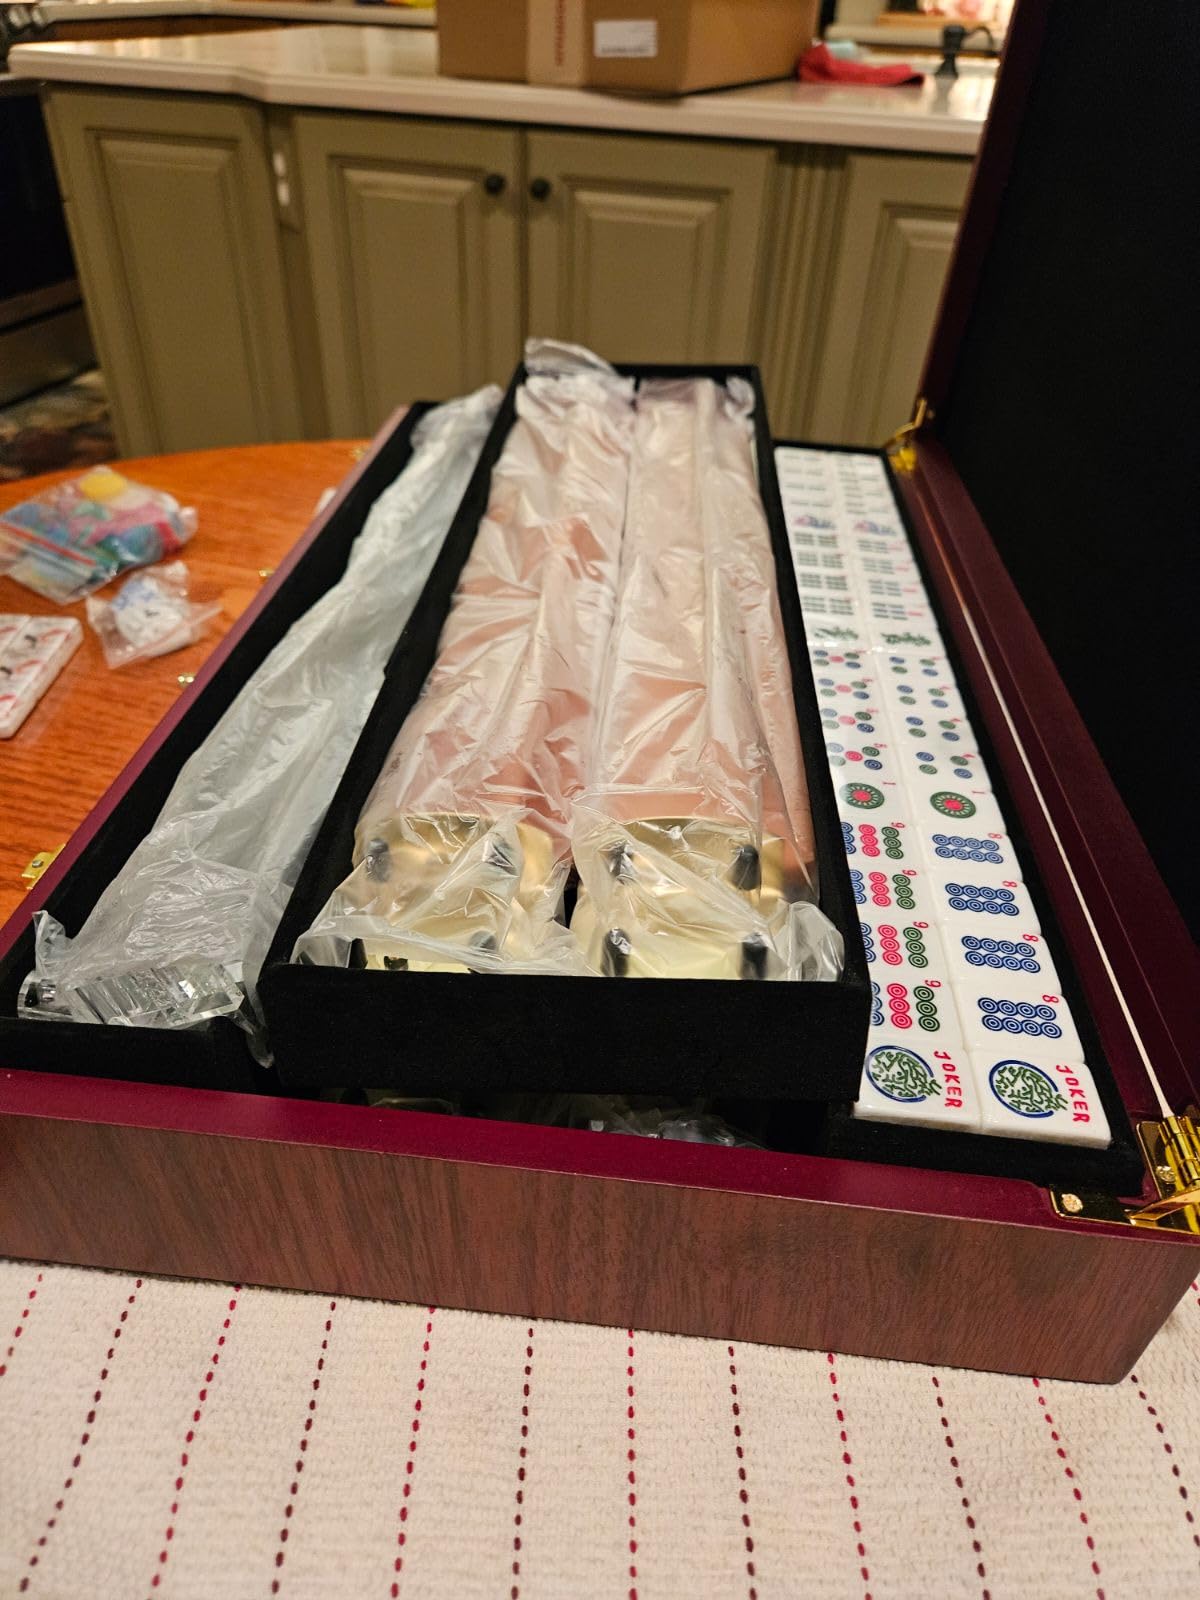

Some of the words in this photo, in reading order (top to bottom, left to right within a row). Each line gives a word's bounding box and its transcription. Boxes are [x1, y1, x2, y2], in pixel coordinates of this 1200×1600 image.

[891, 821, 906, 829] 9
[987, 832, 1002, 840] 8
[902, 869, 917, 877] 9
[1002, 880, 1018, 888] 8
[913, 921, 929, 929] 9
[1022, 933, 1039, 943] 8
[924, 979, 942, 988] 9
[1042, 994, 1060, 1004] 8
[934, 1050, 963, 1108] JOKER
[1056, 1064, 1091, 1123] JOKER
